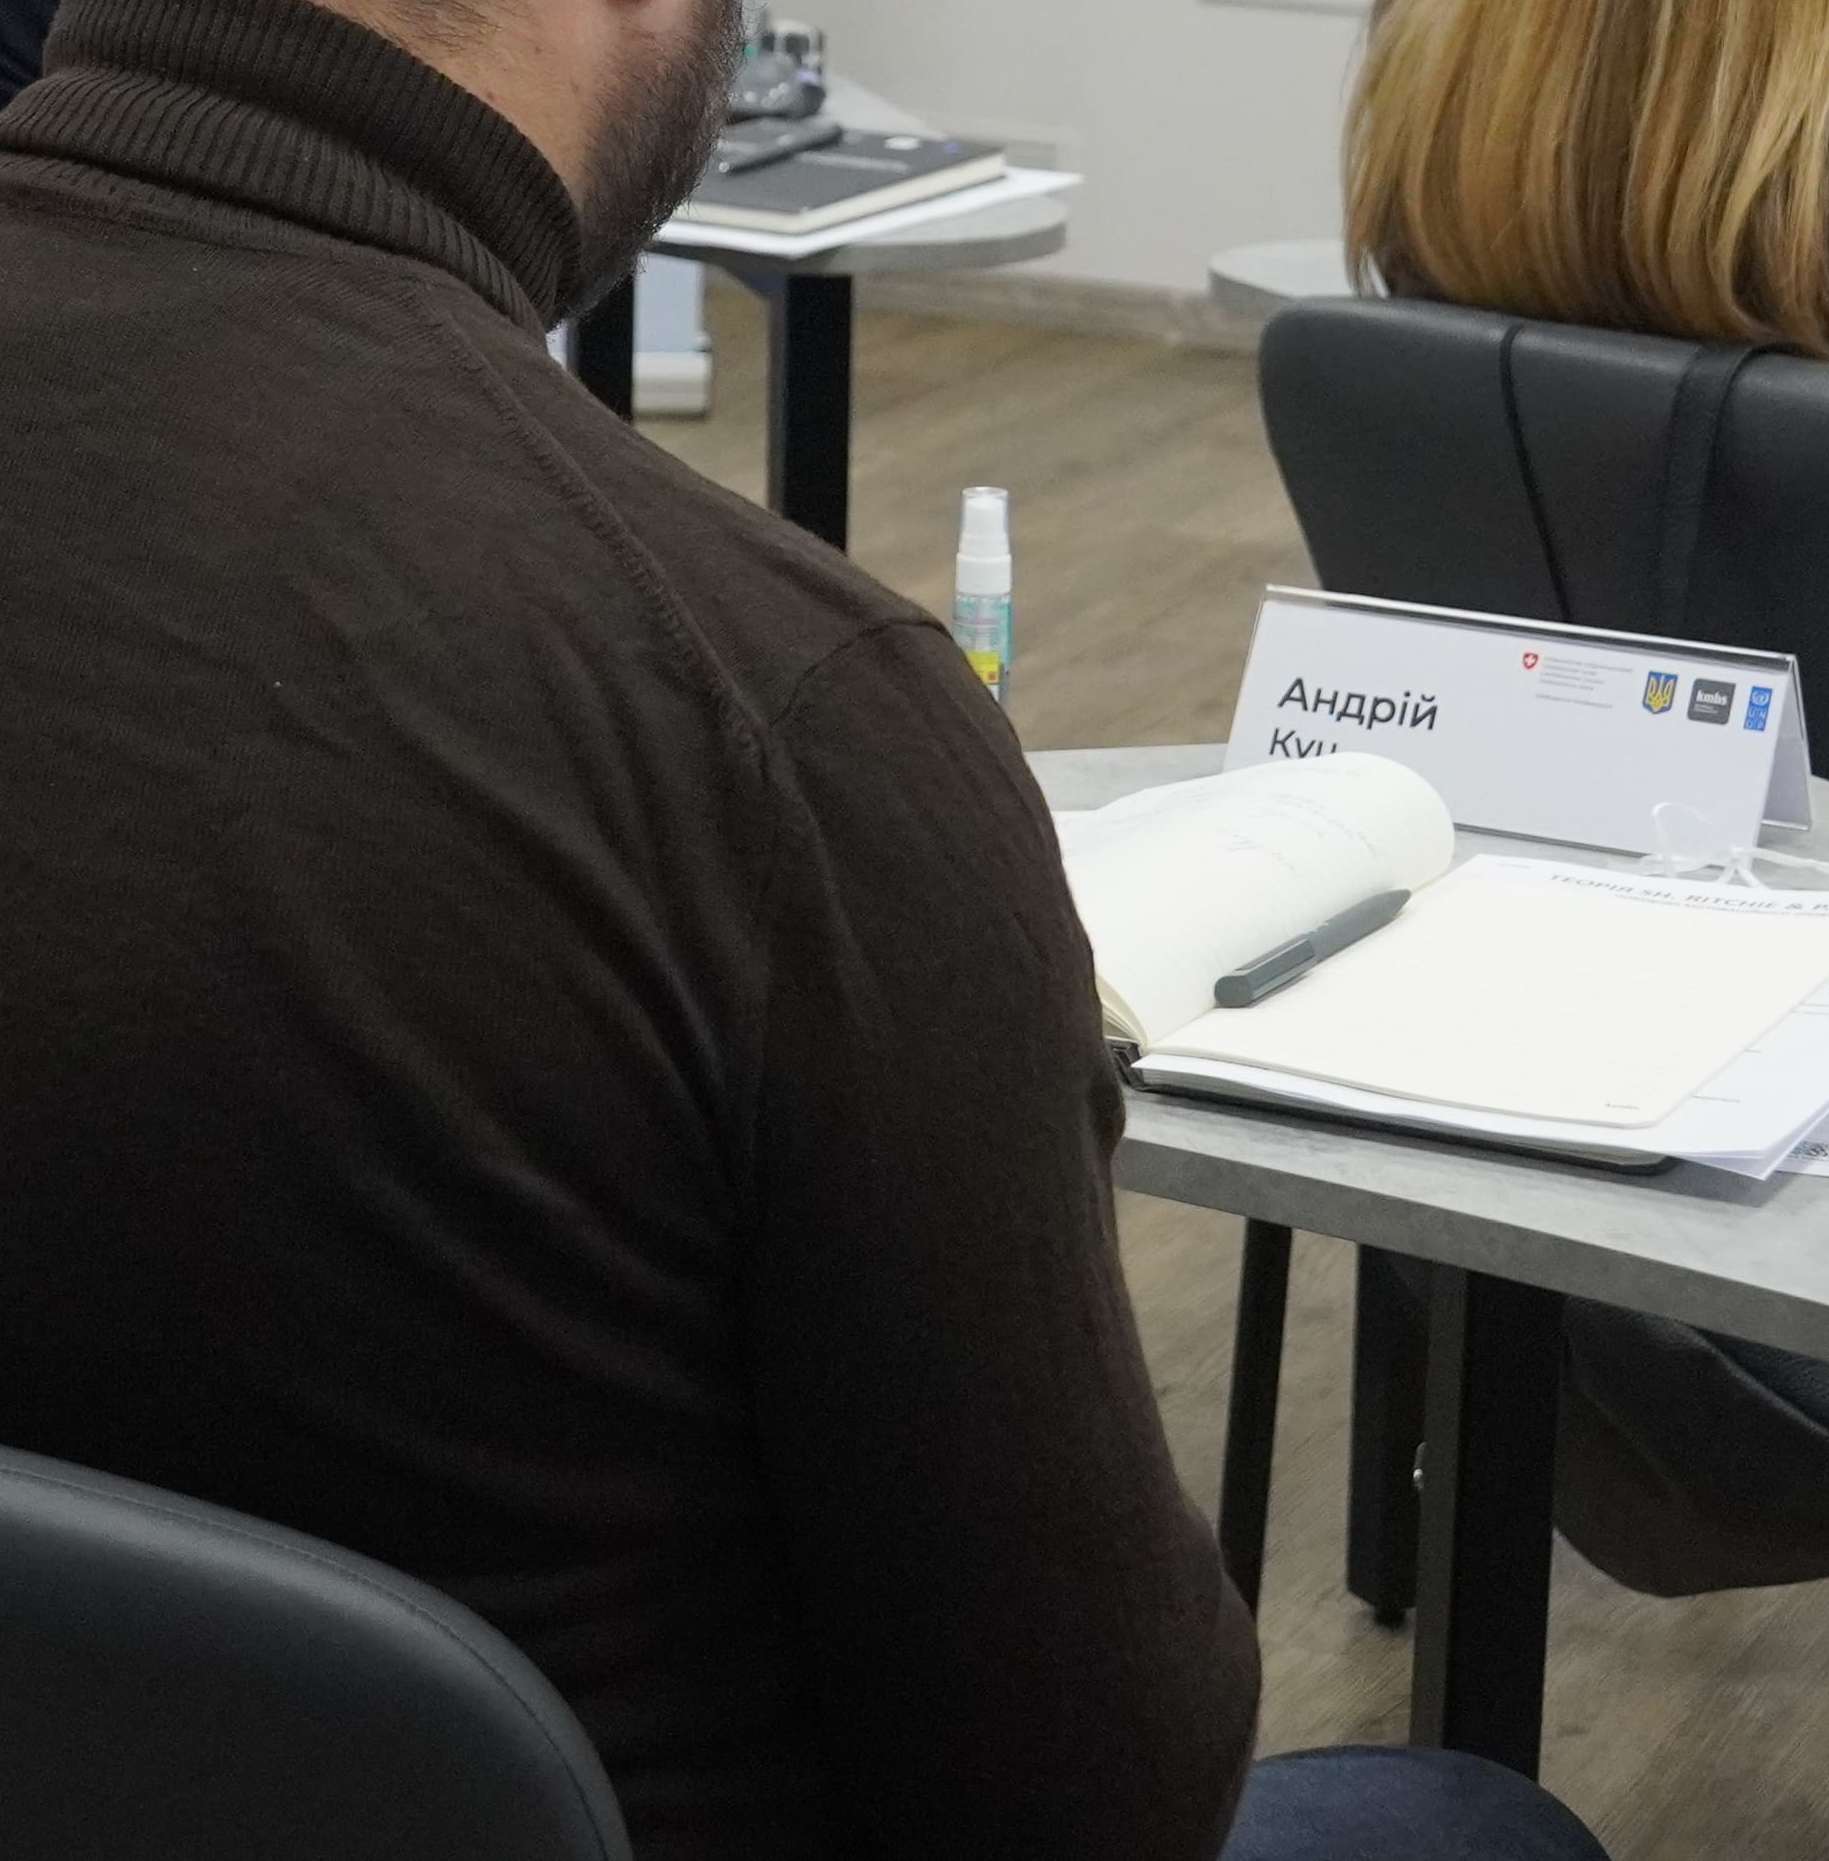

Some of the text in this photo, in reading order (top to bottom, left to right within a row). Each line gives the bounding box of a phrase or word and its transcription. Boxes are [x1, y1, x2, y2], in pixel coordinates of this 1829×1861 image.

[1276, 677, 1439, 731] Андрій
[1695, 689, 1728, 706] kmbs
[1684, 893, 1776, 910] RITCHIE
